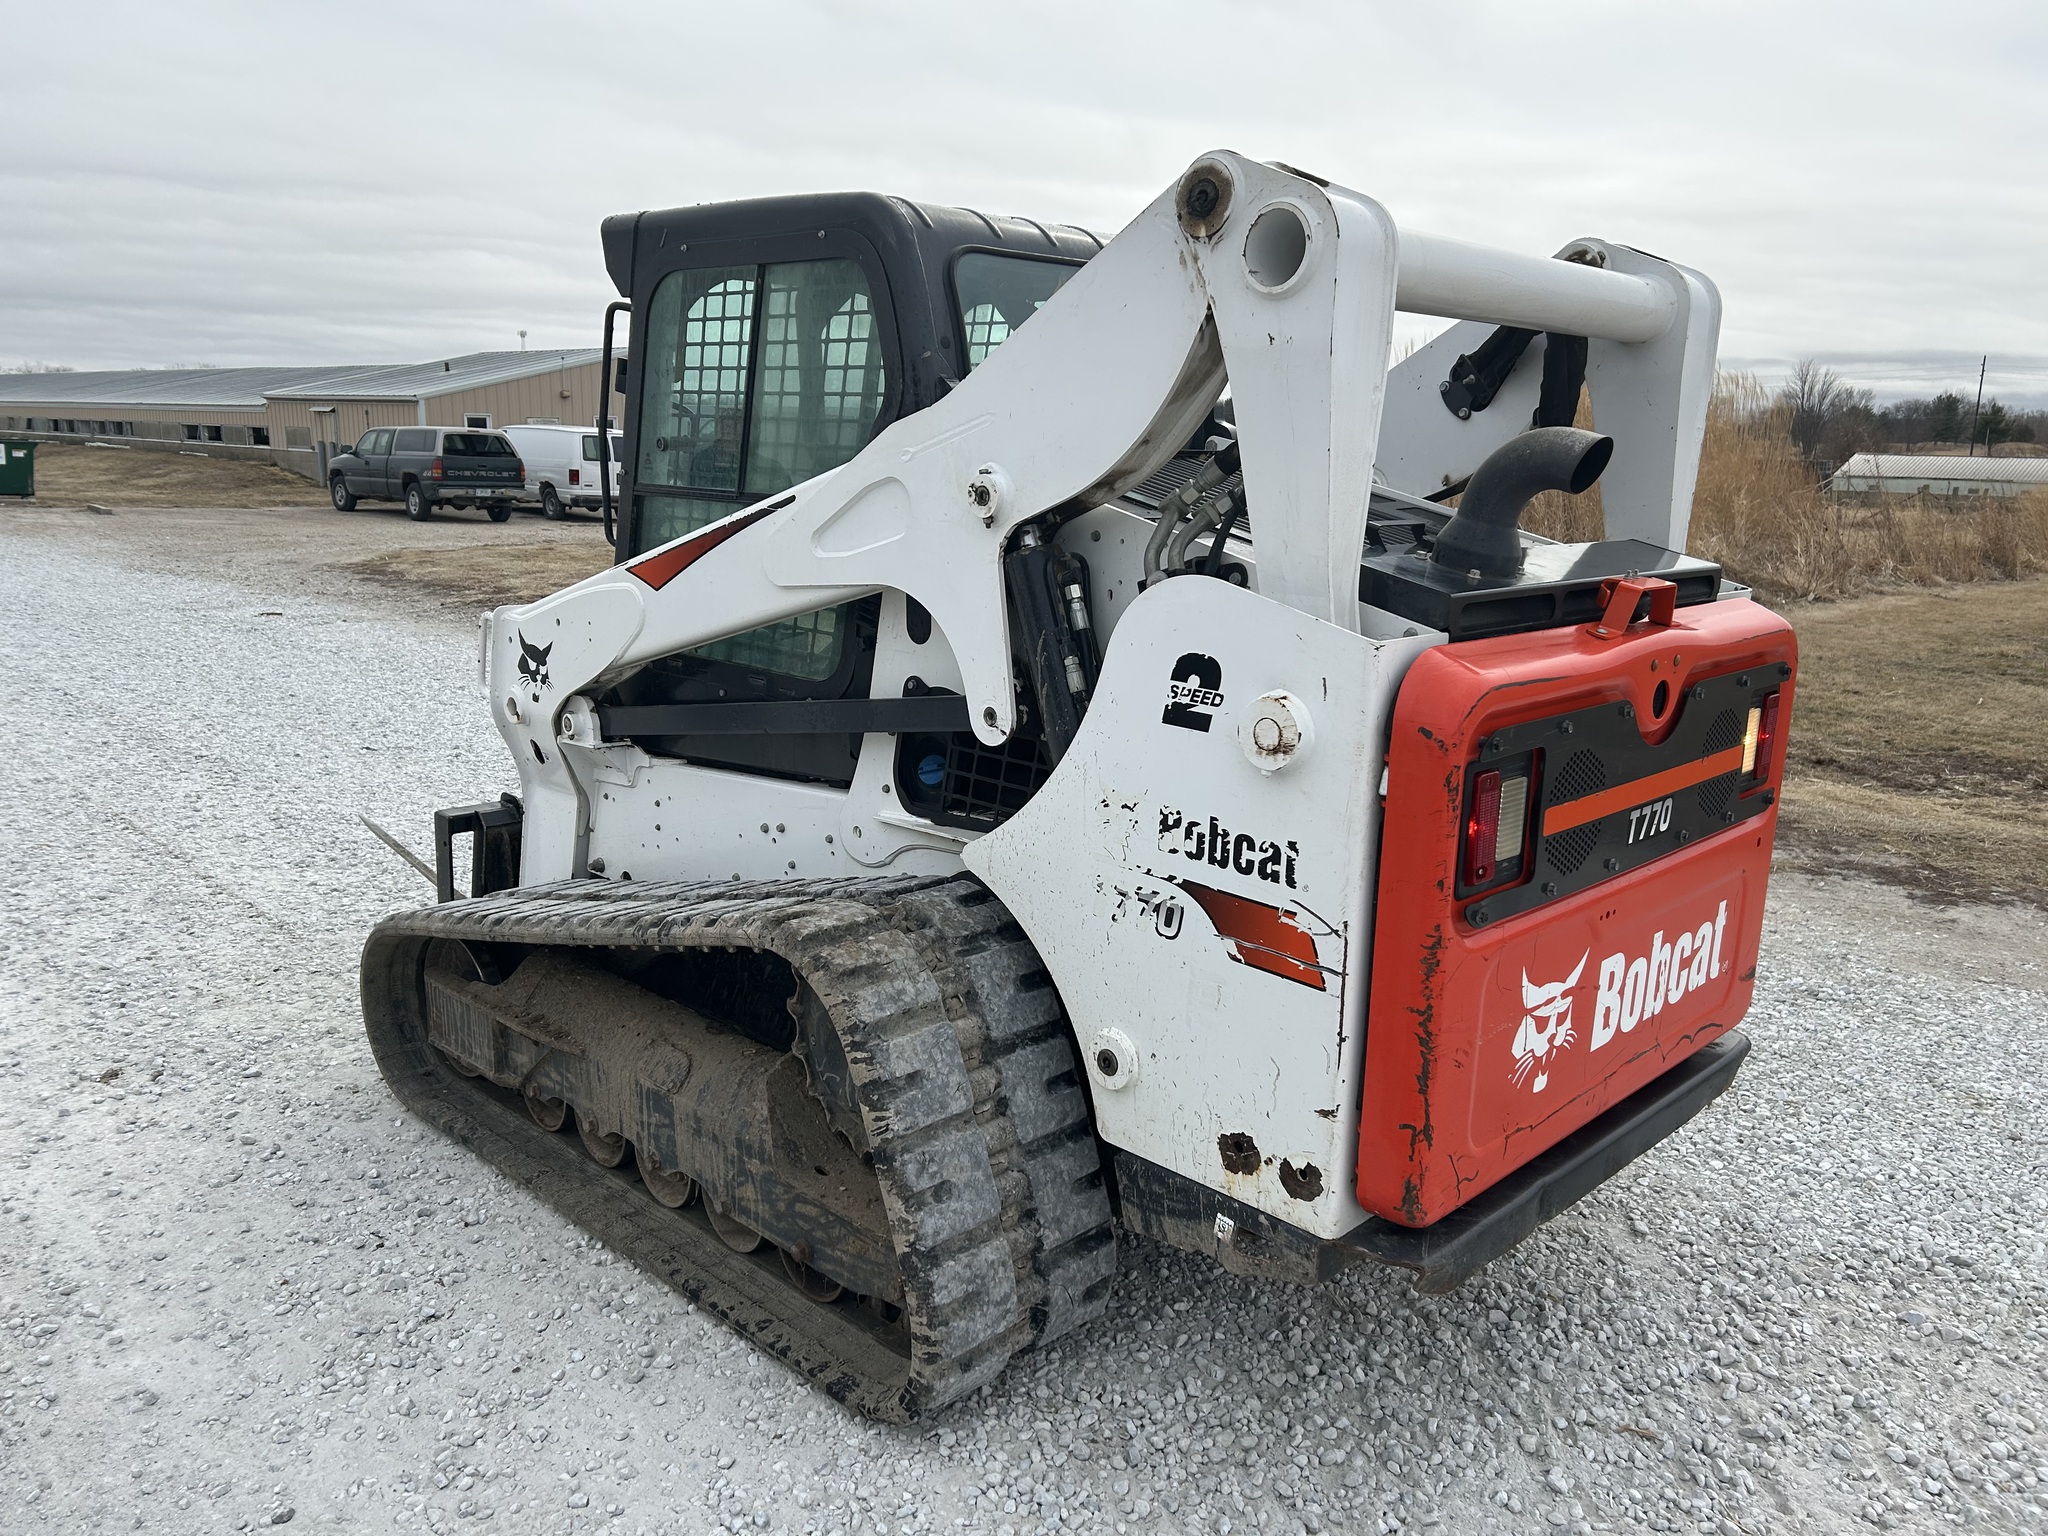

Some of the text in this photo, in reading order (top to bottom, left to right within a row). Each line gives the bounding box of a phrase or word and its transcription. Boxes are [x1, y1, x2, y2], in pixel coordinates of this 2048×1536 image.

[446, 470, 517, 478] CHEVROLET
[1161, 652, 1222, 734] 2
[1169, 684, 1225, 708] SPEED
[1628, 797, 1673, 845] T770
[1589, 899, 1728, 1053] Bobcat
